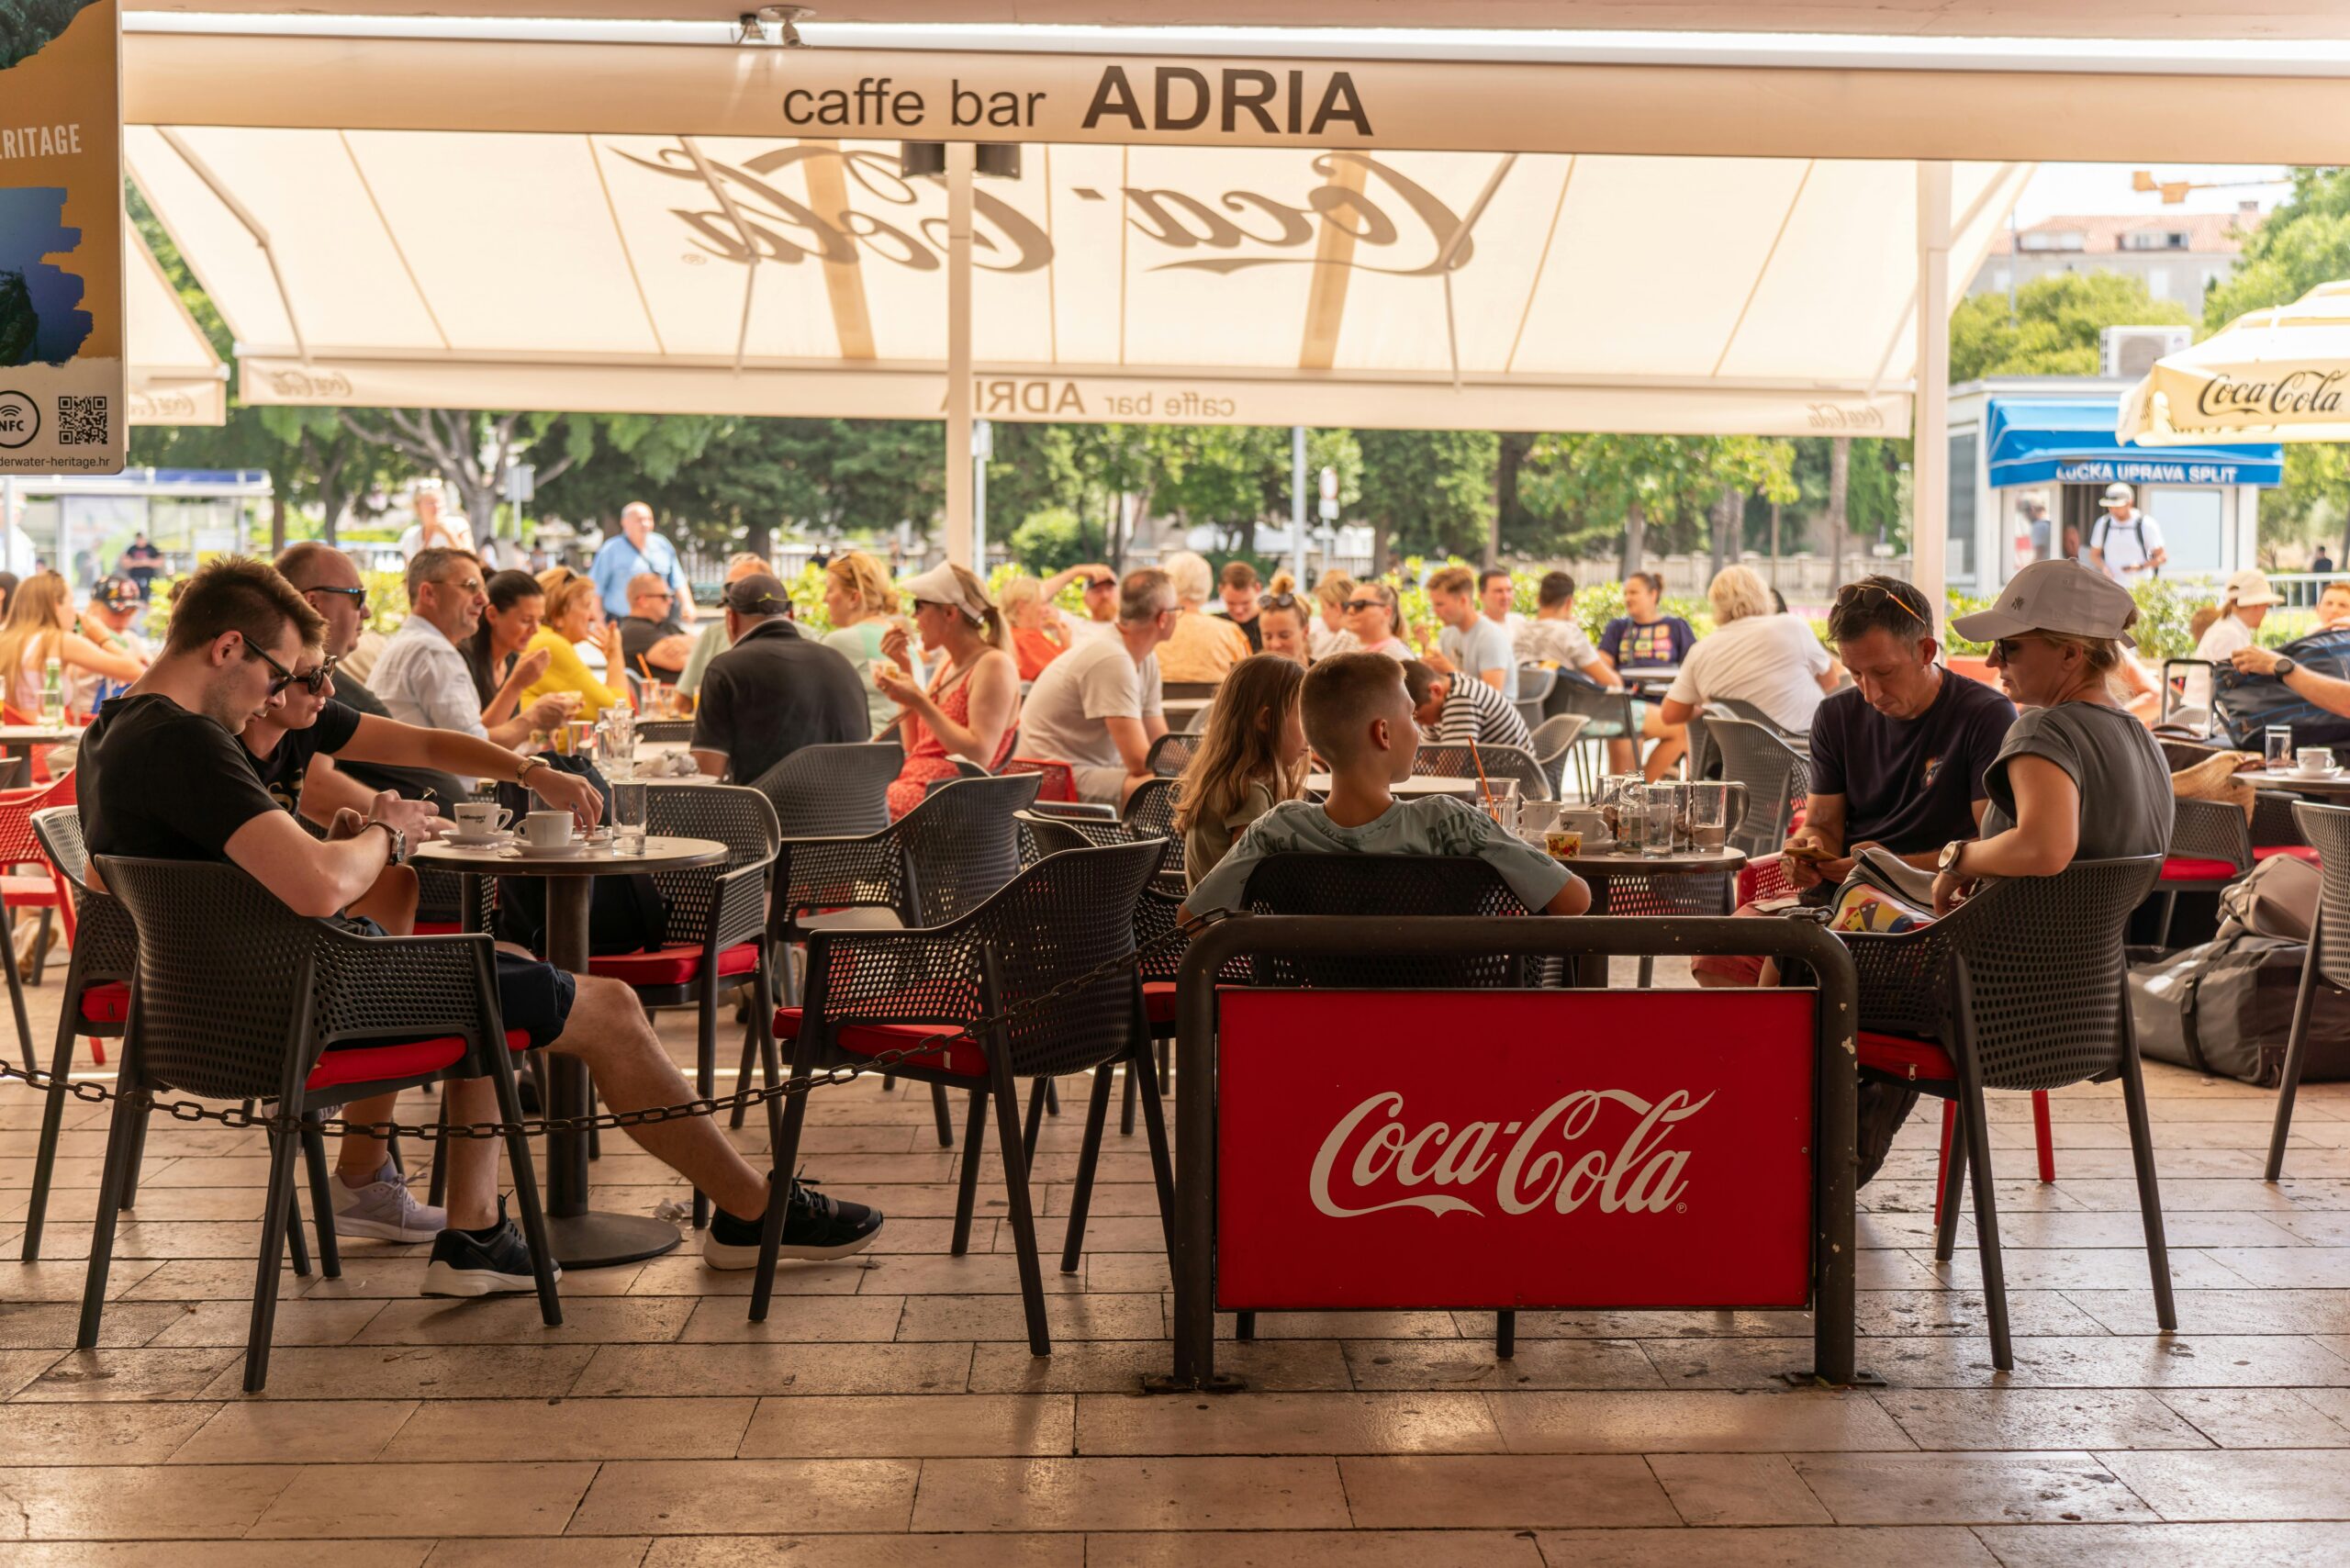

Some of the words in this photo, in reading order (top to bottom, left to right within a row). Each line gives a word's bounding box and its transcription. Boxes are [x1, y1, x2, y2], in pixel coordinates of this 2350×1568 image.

[783, 77, 924, 127] caffe
[951, 79, 1046, 128] bar
[1081, 65, 1373, 137] ADRIA
[0, 124, 82, 160] RITAGE
[2199, 369, 2350, 417] Coca-Cola
[0, 420, 25, 432] NFC
[2117, 462, 2186, 483] UPRAVA
[2188, 465, 2238, 484] SPLIT
[1309, 1089, 1717, 1218] Coca-Cola
